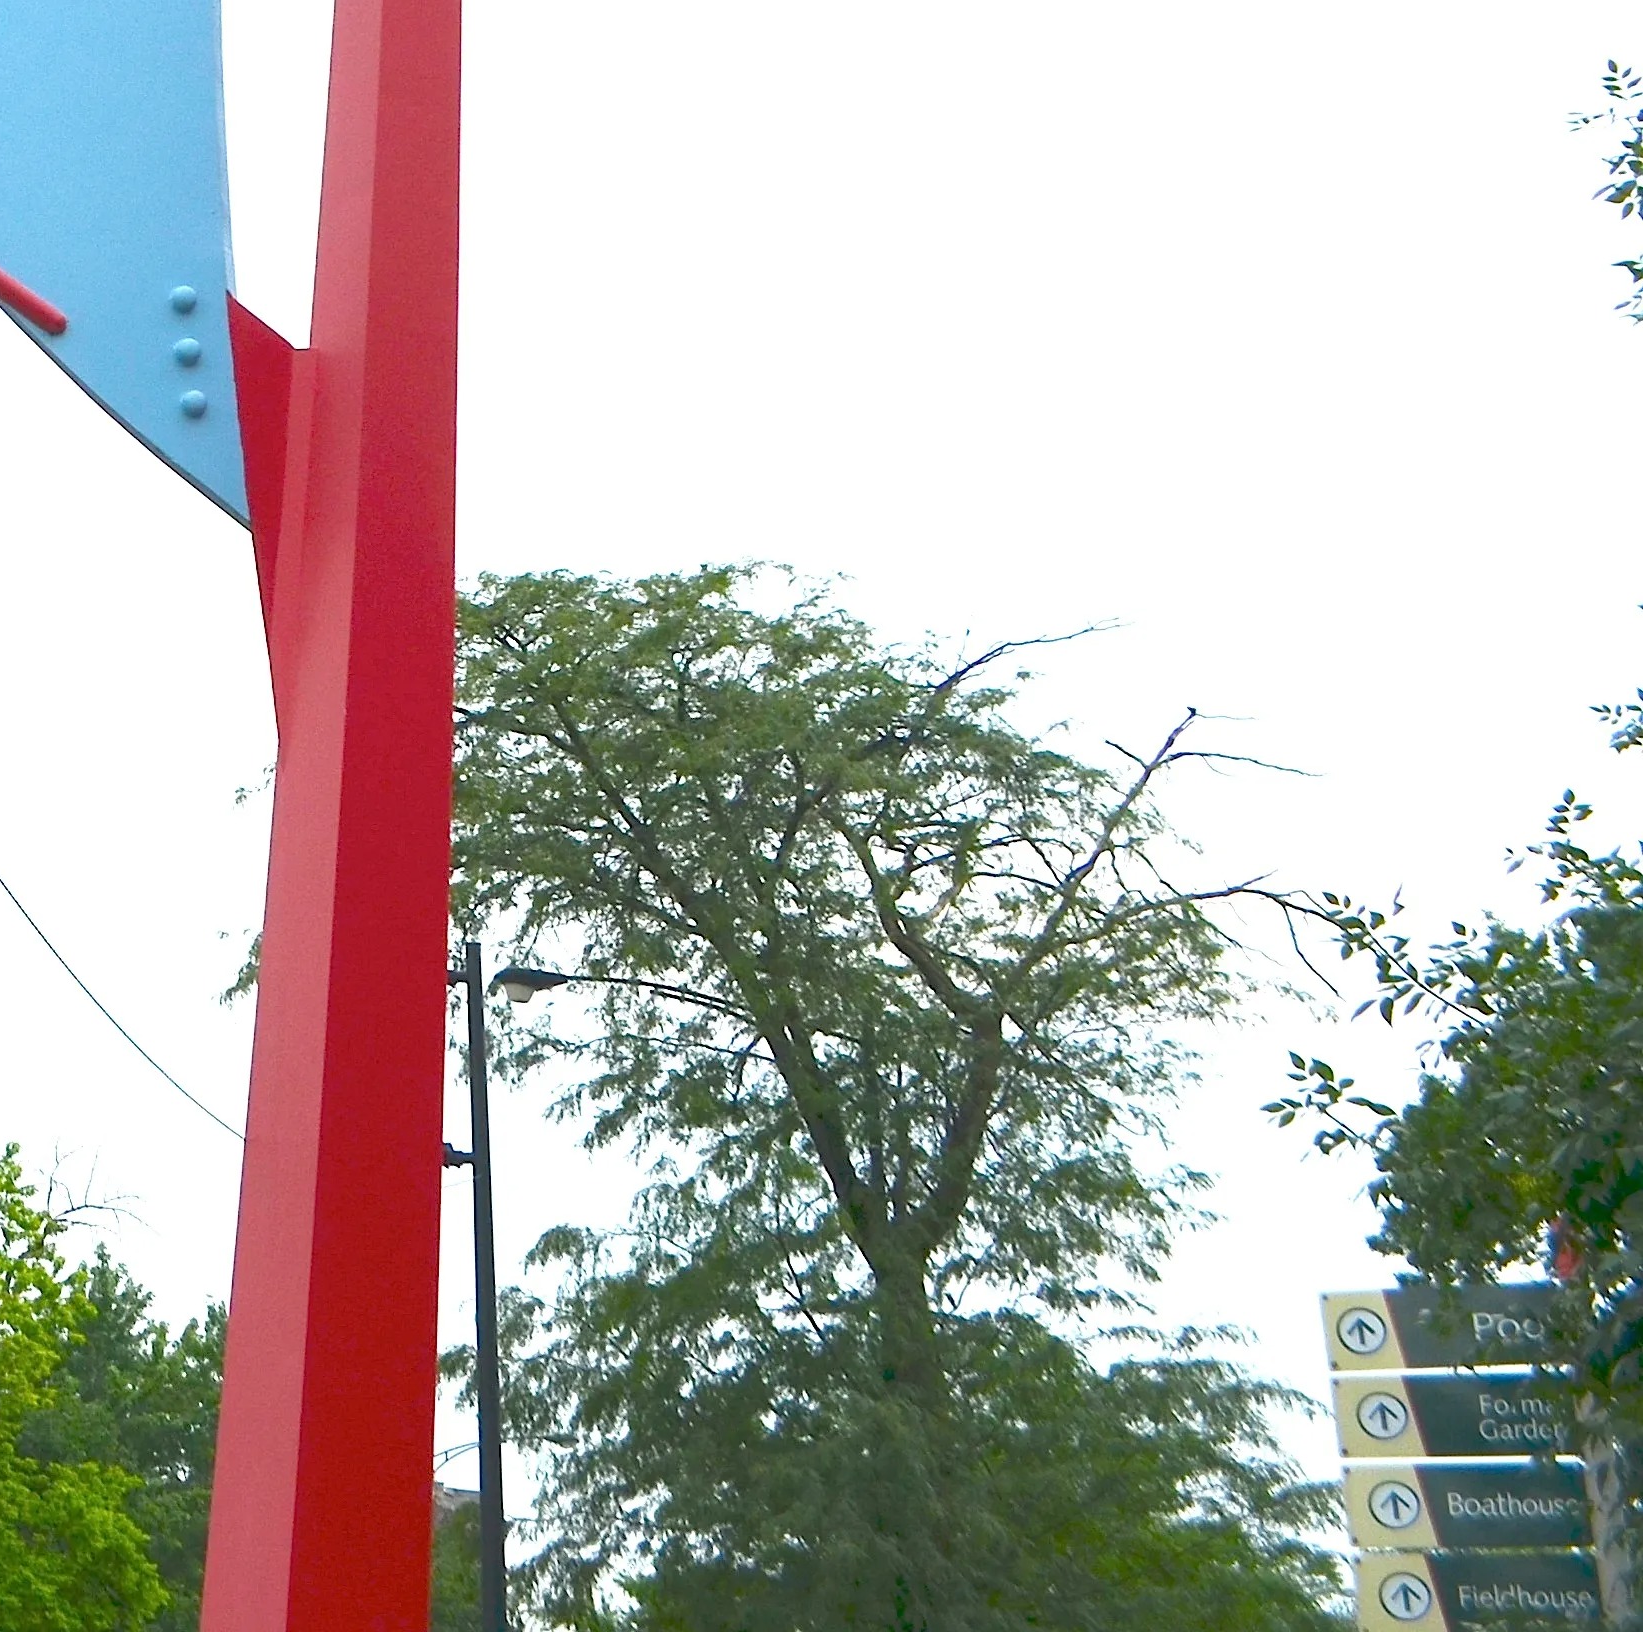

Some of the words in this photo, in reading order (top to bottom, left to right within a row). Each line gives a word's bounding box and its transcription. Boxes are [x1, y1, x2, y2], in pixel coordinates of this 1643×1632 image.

[1472, 1311, 1546, 1342] Poo
[1447, 1491, 1581, 1518] Boathouse
[1458, 1583, 1595, 1611] Fieldhouse
